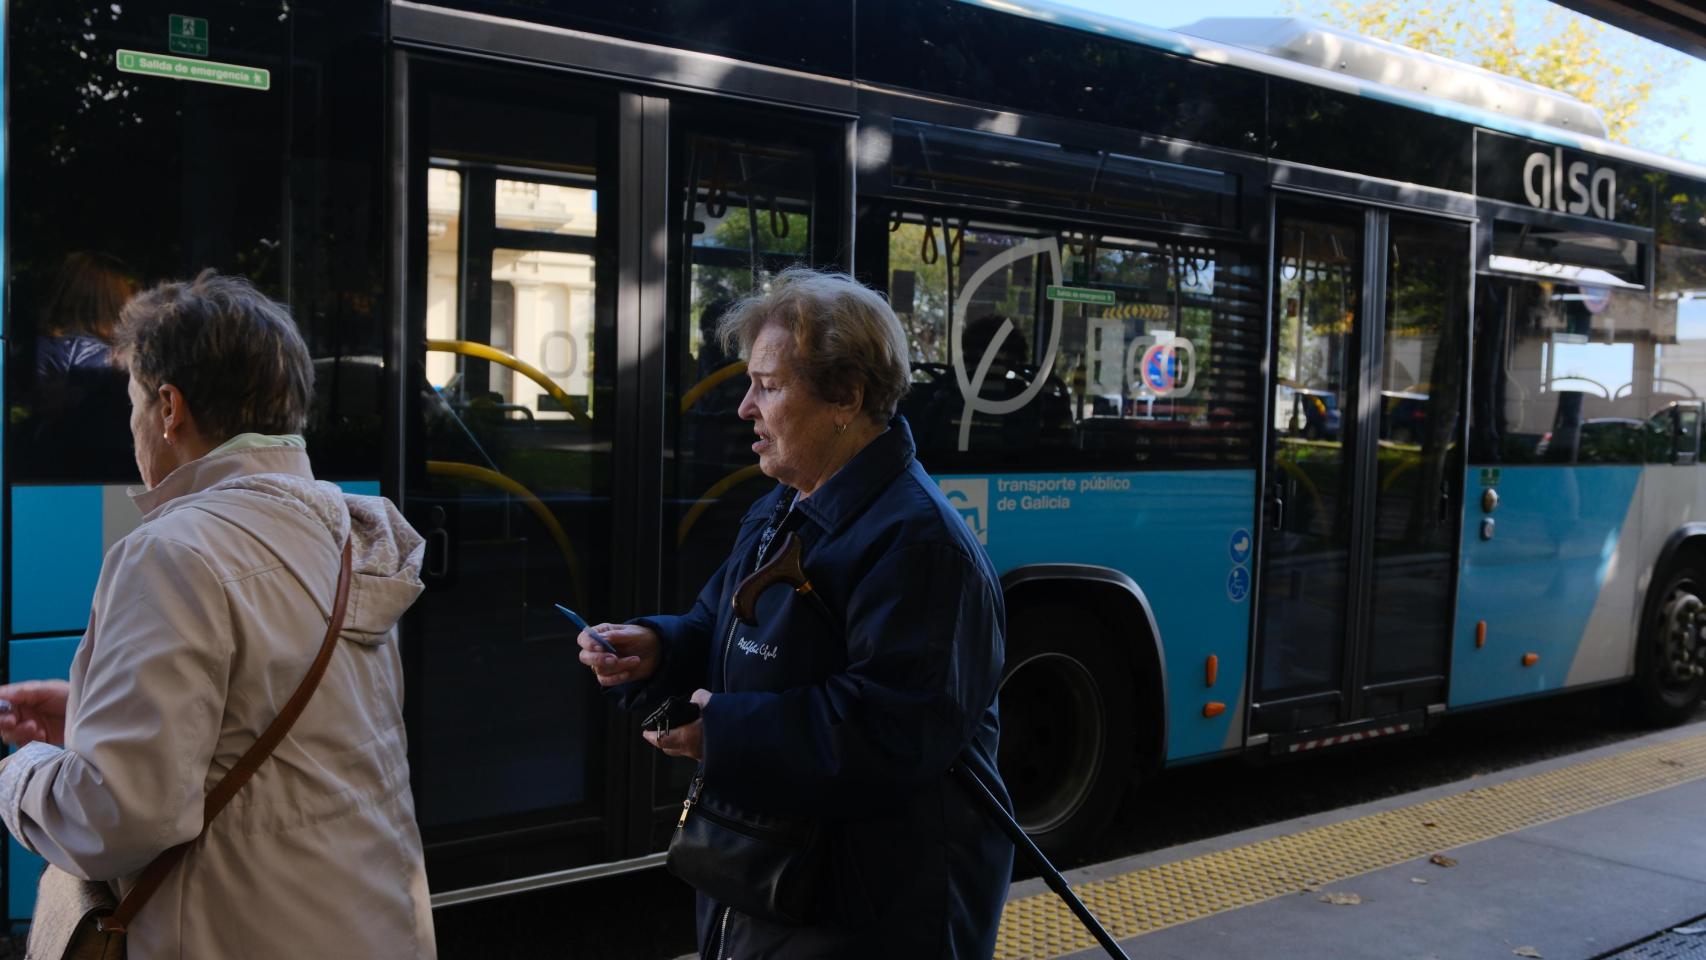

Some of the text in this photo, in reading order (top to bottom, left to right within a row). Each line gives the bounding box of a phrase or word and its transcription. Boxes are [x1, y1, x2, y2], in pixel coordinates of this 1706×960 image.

[139, 57, 249, 81] Salida de emergencia
[1523, 146, 1616, 221] alsa
[997, 476, 1130, 494] transporte público
[997, 495, 1070, 511] de Galicia
